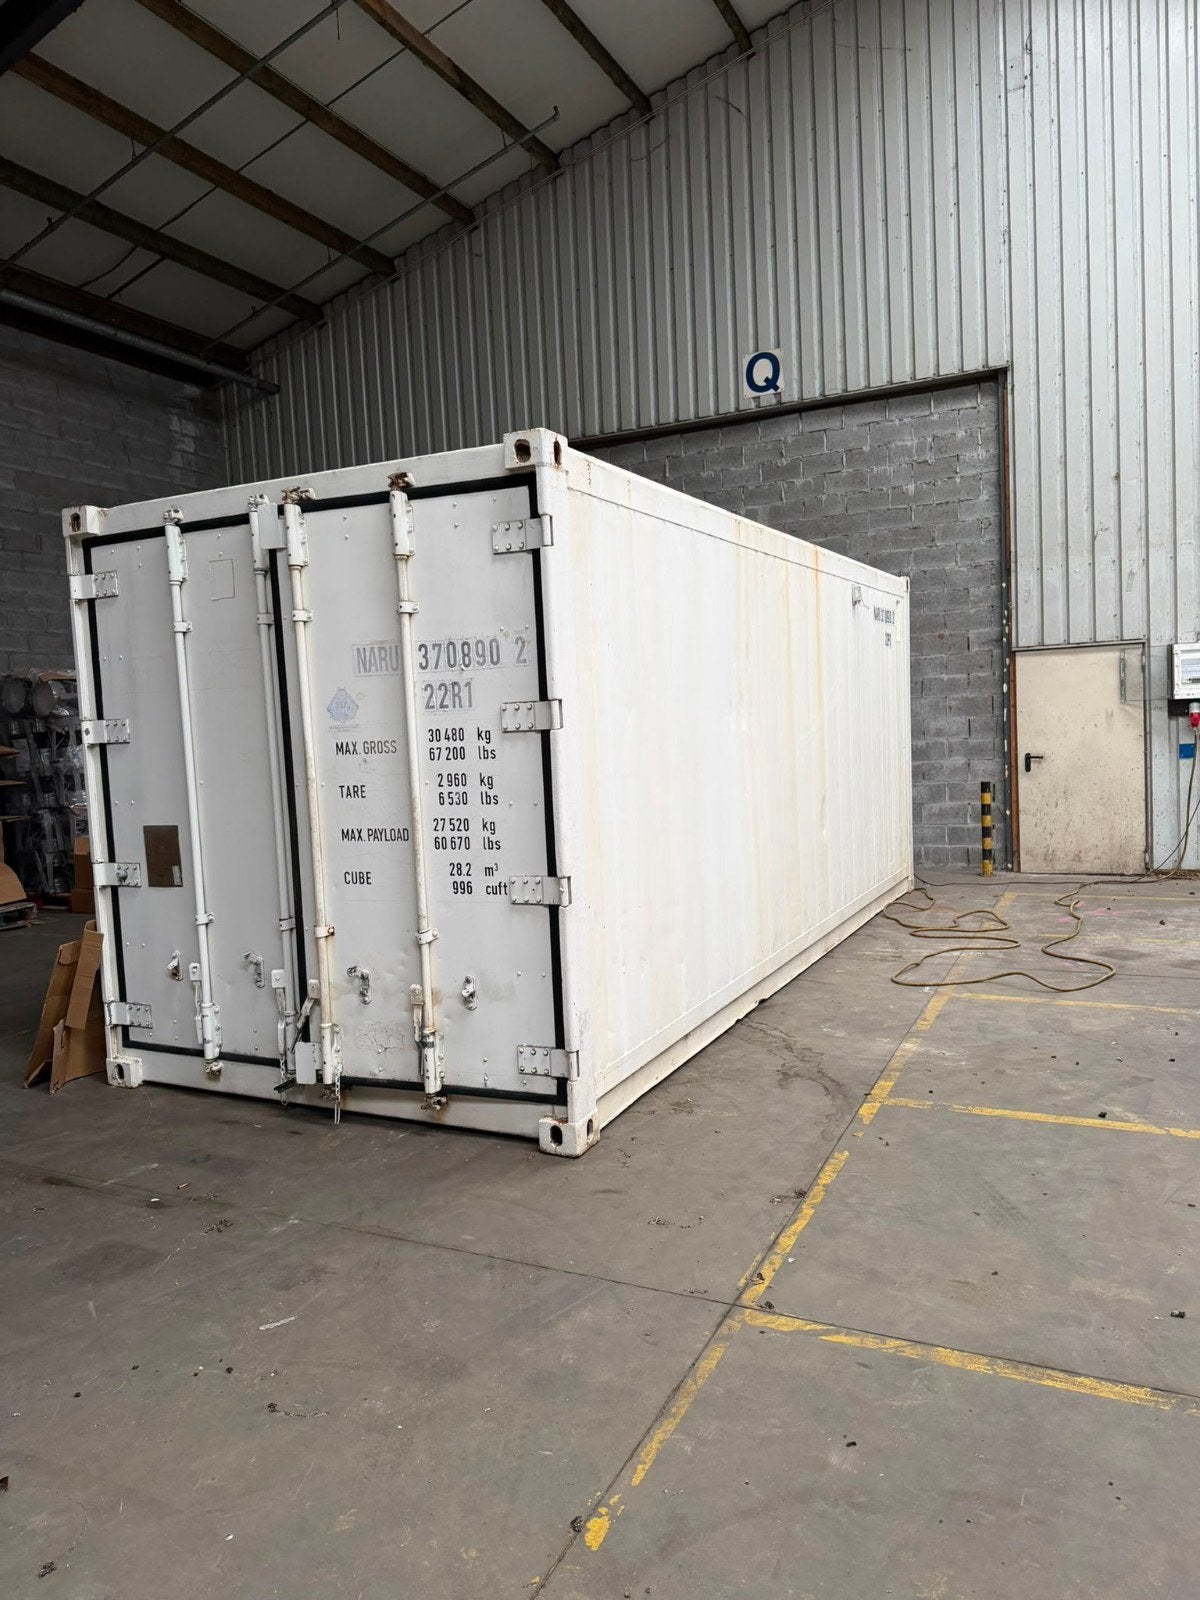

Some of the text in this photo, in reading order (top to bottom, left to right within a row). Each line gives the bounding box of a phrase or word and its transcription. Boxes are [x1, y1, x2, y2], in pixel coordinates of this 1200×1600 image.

[746, 352, 780, 393] Q
[356, 636, 527, 673] NARU 370890 2
[424, 681, 473, 709] 22R1
[477, 727, 491, 743] kg
[478, 746, 496, 759] lbs
[479, 773, 494, 789] kg
[339, 785, 366, 798] TARE
[480, 792, 498, 805] lbs
[482, 818, 496, 834] kg
[482, 837, 501, 850] lbs
[449, 863, 472, 876] 28.2
[344, 871, 372, 885] CUBE
[452, 881, 473, 895] 996
